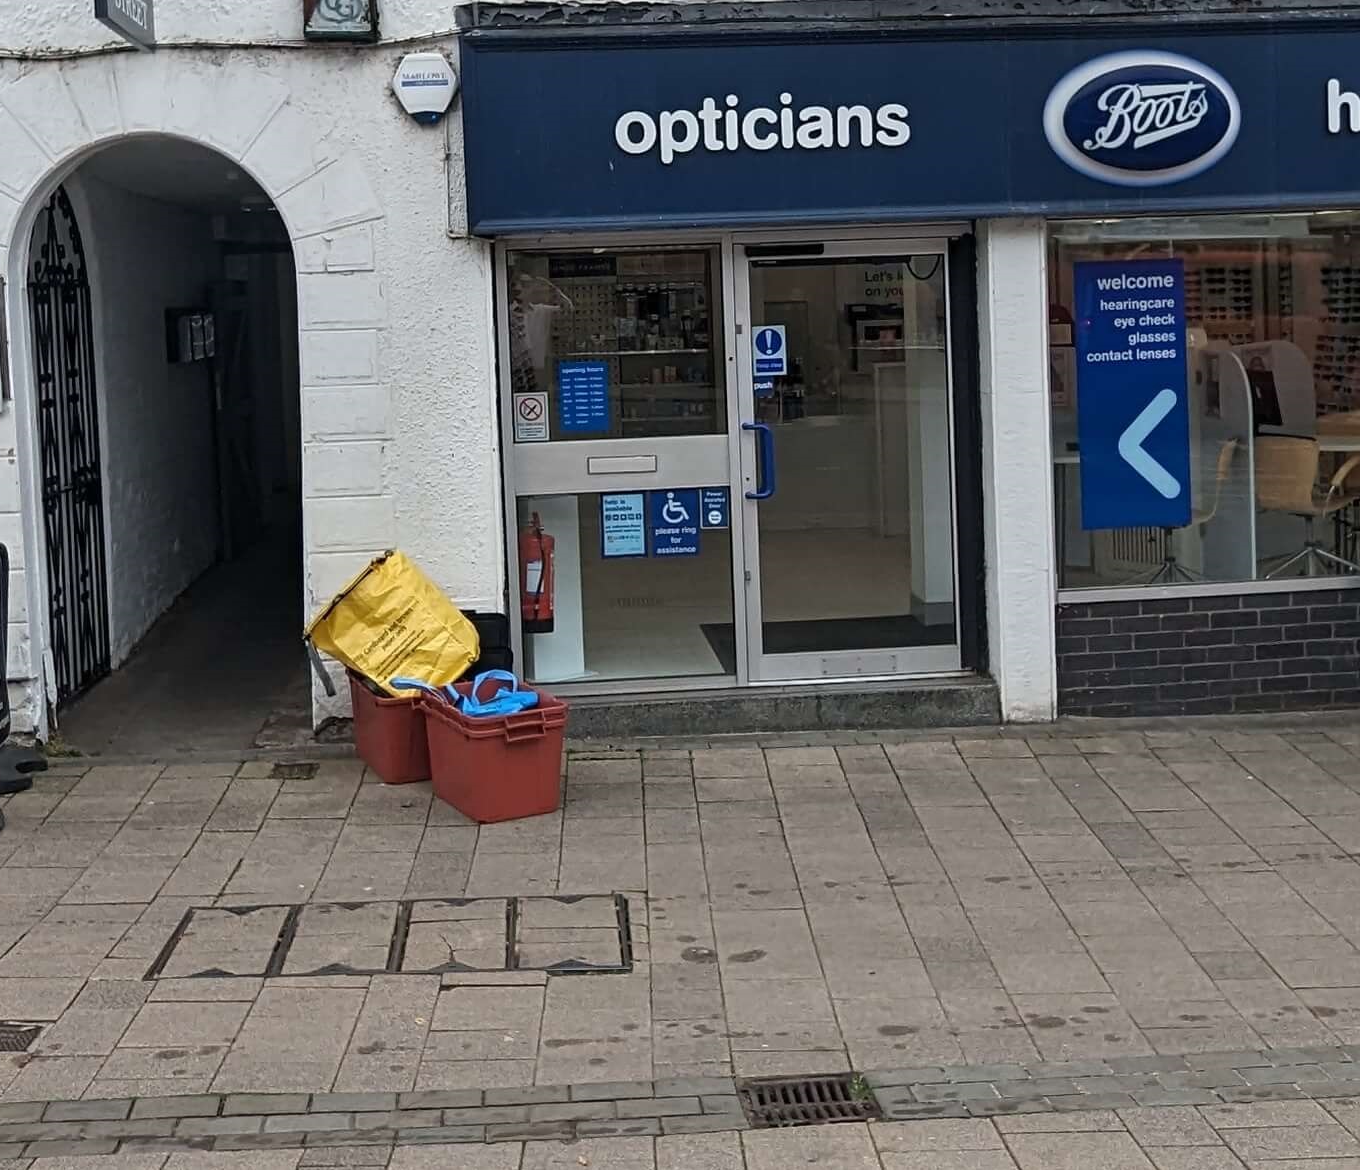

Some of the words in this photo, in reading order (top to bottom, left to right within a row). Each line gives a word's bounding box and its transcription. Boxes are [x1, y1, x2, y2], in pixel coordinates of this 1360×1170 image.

[1083, 80, 1208, 150] Boots
[615, 92, 911, 164] opticians
[864, 270, 893, 282] Let's
[1097, 273, 1174, 290] welcome
[865, 287, 881, 296] on
[1100, 298, 1175, 311] hearingcare
[1114, 317, 1135, 329] eye
[1139, 313, 1175, 326] check
[1128, 331, 1176, 346] glasses
[1086, 349, 1133, 362] contact
[1136, 348, 1176, 360] lenses
[753, 381, 773, 390] push
[655, 527, 680, 536] please
[681, 526, 697, 535] ring
[670, 536, 682, 544] for
[656, 546, 697, 555] assistance
